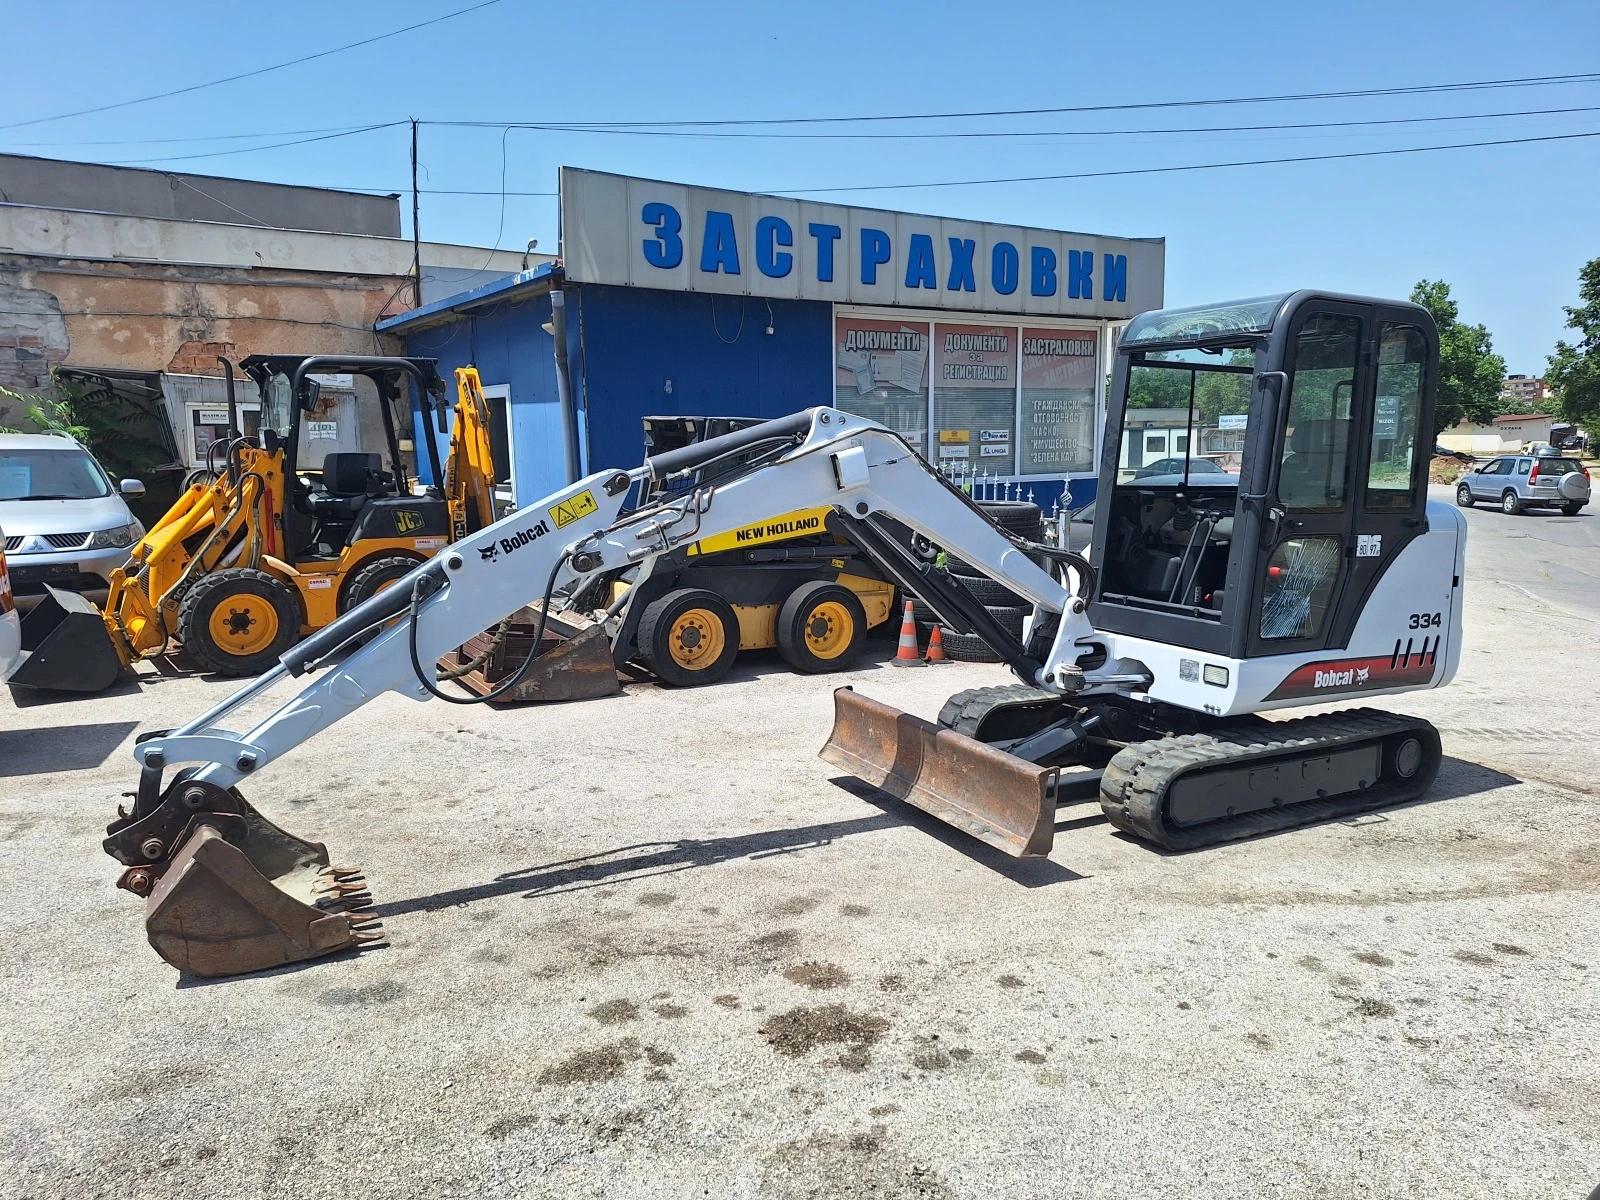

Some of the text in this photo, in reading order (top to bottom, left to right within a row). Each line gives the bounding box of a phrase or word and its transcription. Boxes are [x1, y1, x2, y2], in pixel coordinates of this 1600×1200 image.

[641, 202, 1127, 302] ЗАСТРАХОВКИ
[845, 330, 920, 352] ДОКУМЕНТИ
[944, 333, 1008, 352] ДОКУМЕНТИ
[1024, 337, 1094, 356] ЗАСТРАХОВКИ
[969, 352, 983, 362] за
[943, 364, 1007, 382] РЕГИСТРАЦИЯ
[499, 519, 550, 555] Bobcat
[736, 517, 819, 542] NEW HOLLAND
[1409, 612, 1441, 630] 334
[1314, 668, 1354, 688] Bobcat
